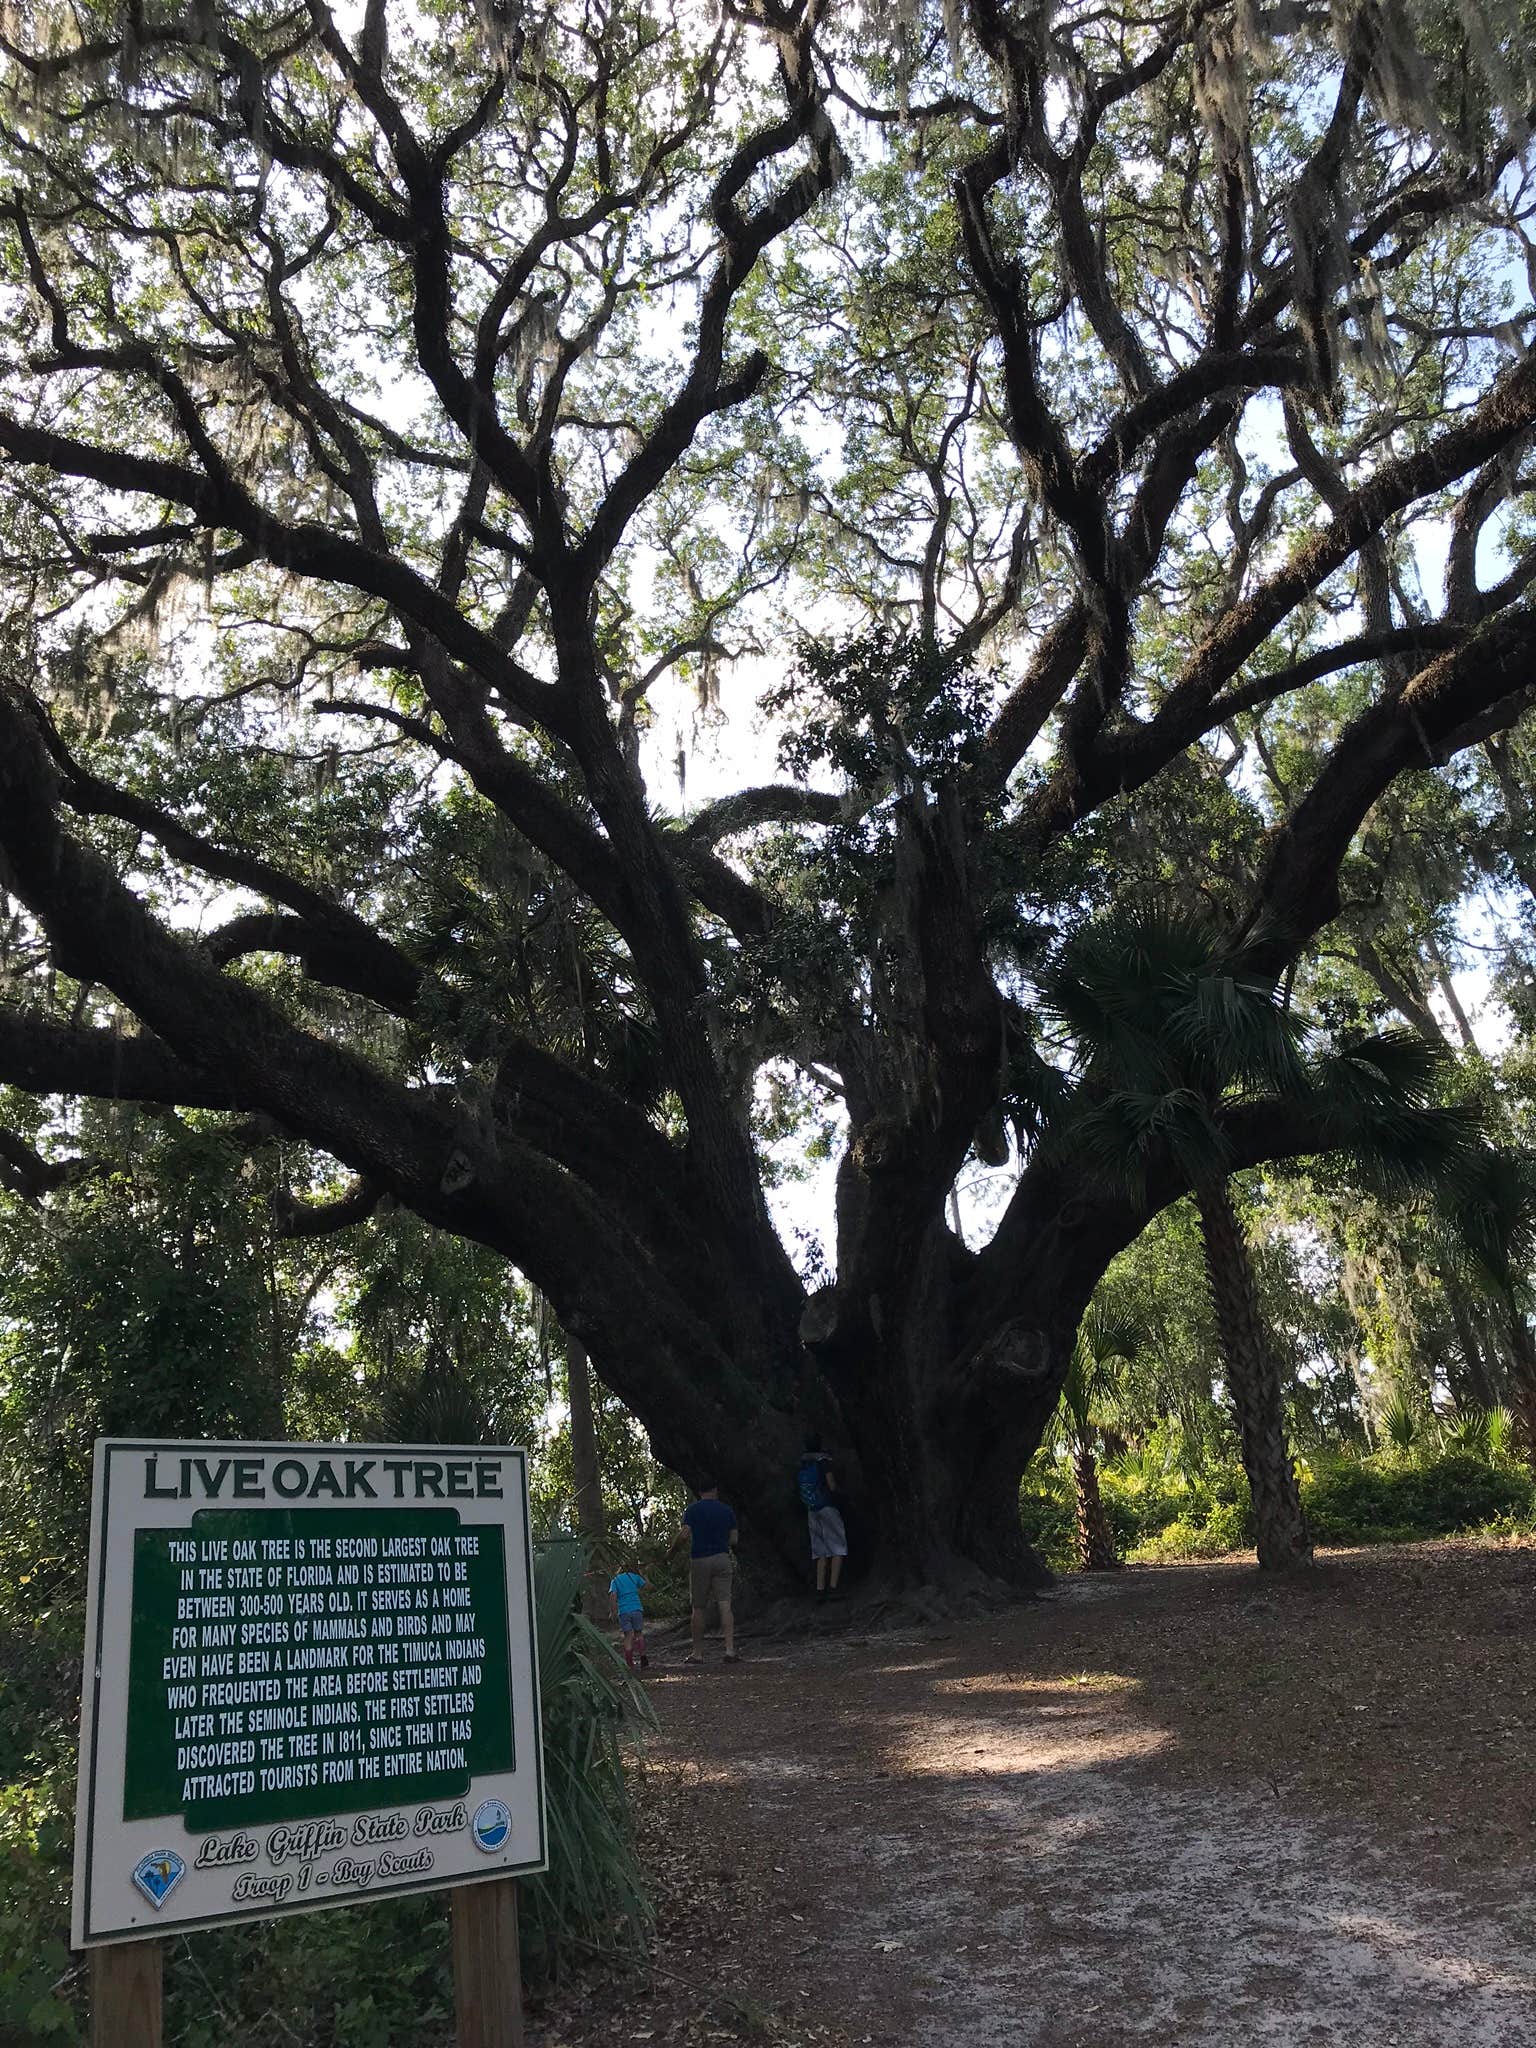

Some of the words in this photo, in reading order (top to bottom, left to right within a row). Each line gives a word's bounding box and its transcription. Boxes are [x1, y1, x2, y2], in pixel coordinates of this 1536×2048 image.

[144, 1457, 265, 1499] LIVE
[272, 1460, 378, 1499] OAK
[383, 1459, 503, 1499] TREE
[169, 1541, 196, 1562] THIS
[202, 1541, 227, 1561] LIVE
[233, 1540, 256, 1561] OAK
[261, 1540, 290, 1560] TREE
[295, 1540, 305, 1559] IS
[310, 1538, 331, 1559] THE
[336, 1538, 377, 1558] SECOND
[382, 1537, 426, 1557] LARGEST
[431, 1537, 451, 1556] OAK
[455, 1536, 479, 1555] TREE
[181, 1570, 193, 1590] IN
[199, 1569, 222, 1590] THE
[227, 1567, 262, 1589] STATE
[267, 1567, 282, 1587] OF
[287, 1566, 334, 1587] FLORIDA
[337, 1565, 359, 1585] AND
[364, 1564, 374, 1584] IS
[378, 1563, 434, 1583] ESTIMATED
[437, 1562, 450, 1581] TO
[455, 1562, 467, 1581] BE
[178, 1597, 235, 1620] BETWEEN
[240, 1594, 283, 1617] 300-500
[288, 1593, 324, 1615] YEARS
[329, 1591, 353, 1612] OLD.
[358, 1591, 367, 1611] IT
[372, 1590, 411, 1610] SERVES
[415, 1589, 428, 1608] AS
[433, 1589, 439, 1607] A
[443, 1588, 471, 1607] HOME
[173, 1627, 196, 1649] FOR
[202, 1624, 236, 1647] MANY
[241, 1622, 289, 1645] SPECIES
[294, 1621, 308, 1642] OF
[313, 1618, 367, 1641] MAMMALS
[371, 1616, 392, 1637] AND
[397, 1615, 427, 1636] BIRDS
[431, 1614, 452, 1634] AND
[456, 1613, 475, 1633] MAY
[163, 1656, 196, 1679] EVEN
[202, 1653, 233, 1677] HAVE
[239, 1651, 269, 1674] BEEN
[274, 1651, 282, 1671] A
[287, 1648, 348, 1671] LANDMARK
[353, 1645, 374, 1665] FOR
[378, 1643, 399, 1663] THE
[403, 1640, 442, 1662] TIMUCA
[446, 1638, 485, 1660] INDIANS
[167, 1686, 196, 1709] WHO
[202, 1680, 281, 1706] FREQUENTED
[286, 1678, 307, 1699] THE
[313, 1675, 342, 1697] AREA
[347, 1671, 388, 1694] BEFORE
[392, 1667, 458, 1692] SETTLEMENT
[462, 1665, 482, 1685] AND
[175, 1715, 214, 1739] LATER
[219, 1713, 243, 1734] THE
[248, 1706, 307, 1732] SEMINOLE
[312, 1703, 361, 1726] INDIANS.
[365, 1700, 386, 1721] THE
[391, 1697, 420, 1719] FIRST
[424, 1693, 474, 1715] SETTLERS
[177, 1741, 255, 1771] DISCOVERED
[260, 1738, 283, 1761] THE
[289, 1734, 318, 1757] TREE
[322, 1732, 334, 1754] IN
[370, 1726, 402, 1750] SINCE
[406, 1722, 433, 1745] THEN
[438, 1721, 448, 1741] IT
[452, 1719, 472, 1740] HAS
[182, 1771, 254, 1801] ATTRACTED
[260, 1763, 318, 1791] TOURISTS
[322, 1759, 354, 1784] FROM
[358, 1757, 380, 1779] THE
[384, 1752, 422, 1776] ENTIRE
[427, 1748, 467, 1771] NATION.
[196, 1834, 257, 1866] Lake
[269, 1822, 345, 1862] Griffin
[353, 1815, 407, 1844] State
[414, 1803, 466, 1834] Park
[234, 1874, 291, 1900] Troop
[299, 1866, 310, 1888] 1
[334, 1859, 373, 1884] Boy
[379, 1849, 433, 1874] Scouts
